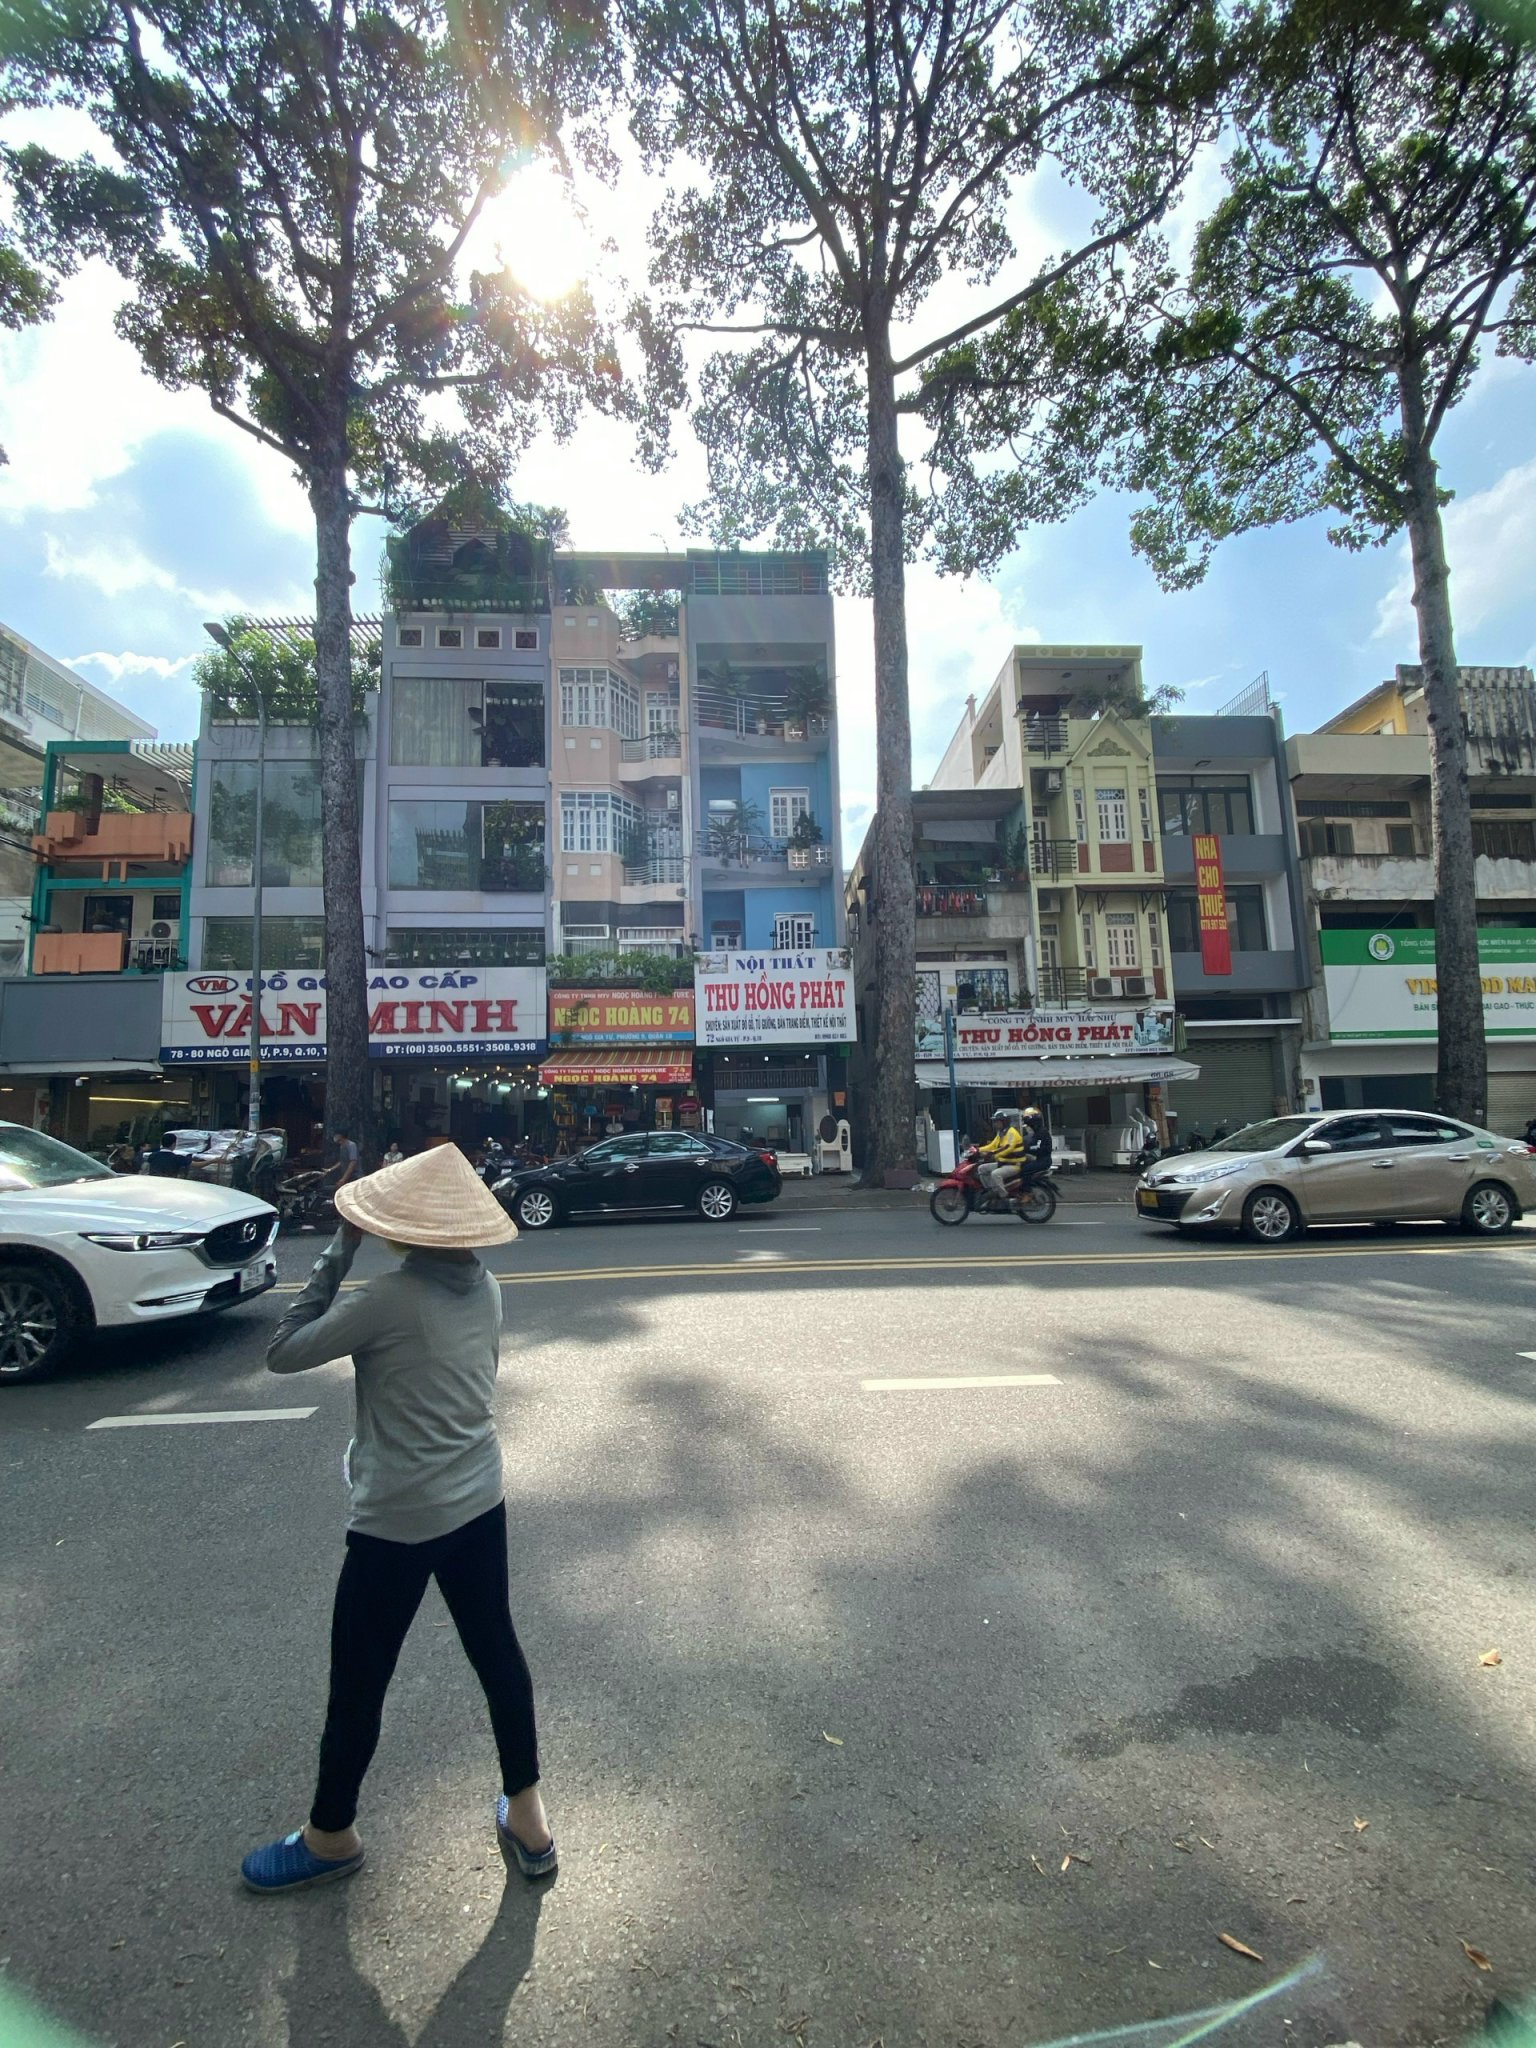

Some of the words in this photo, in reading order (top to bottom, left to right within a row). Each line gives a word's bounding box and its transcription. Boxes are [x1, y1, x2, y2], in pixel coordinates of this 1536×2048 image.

[1196, 835, 1217, 859] NHÀ
[1199, 866, 1219, 888] CHO
[1199, 890, 1224, 916] THUÊ
[736, 956, 764, 974] NỘI
[770, 952, 816, 970] THẤT
[196, 980, 228, 991] VM
[246, 971, 288, 991] ĐỒ
[367, 976, 410, 990] AO
[418, 970, 478, 989] CẤP
[1506, 976, 1536, 993] MA
[612, 992, 630, 1000] NGỌC
[704, 983, 740, 1011] THU
[744, 972, 796, 1010] HỒNG
[800, 973, 846, 1008] PHÁT
[605, 1001, 663, 1026] HOÀNG
[668, 1006, 690, 1025] 74
[988, 1016, 1012, 1024] CÔNG
[1015, 1016, 1025, 1024] TY
[706, 1034, 714, 1043] 72
[958, 1029, 1001, 1044] THU
[1008, 1022, 1072, 1042] HỒNG
[1078, 1022, 1133, 1041] PHÁT
[171, 1050, 184, 1059] 78
[191, 1050, 204, 1058] 80
[206, 1047, 230, 1058] NGÔ
[232, 1048, 250, 1058] GIA
[260, 1047, 272, 1059] Ự,
[554, 1074, 589, 1084] NGỌC
[593, 1074, 638, 1082] HOÀNG
[641, 1074, 658, 1082] 74
